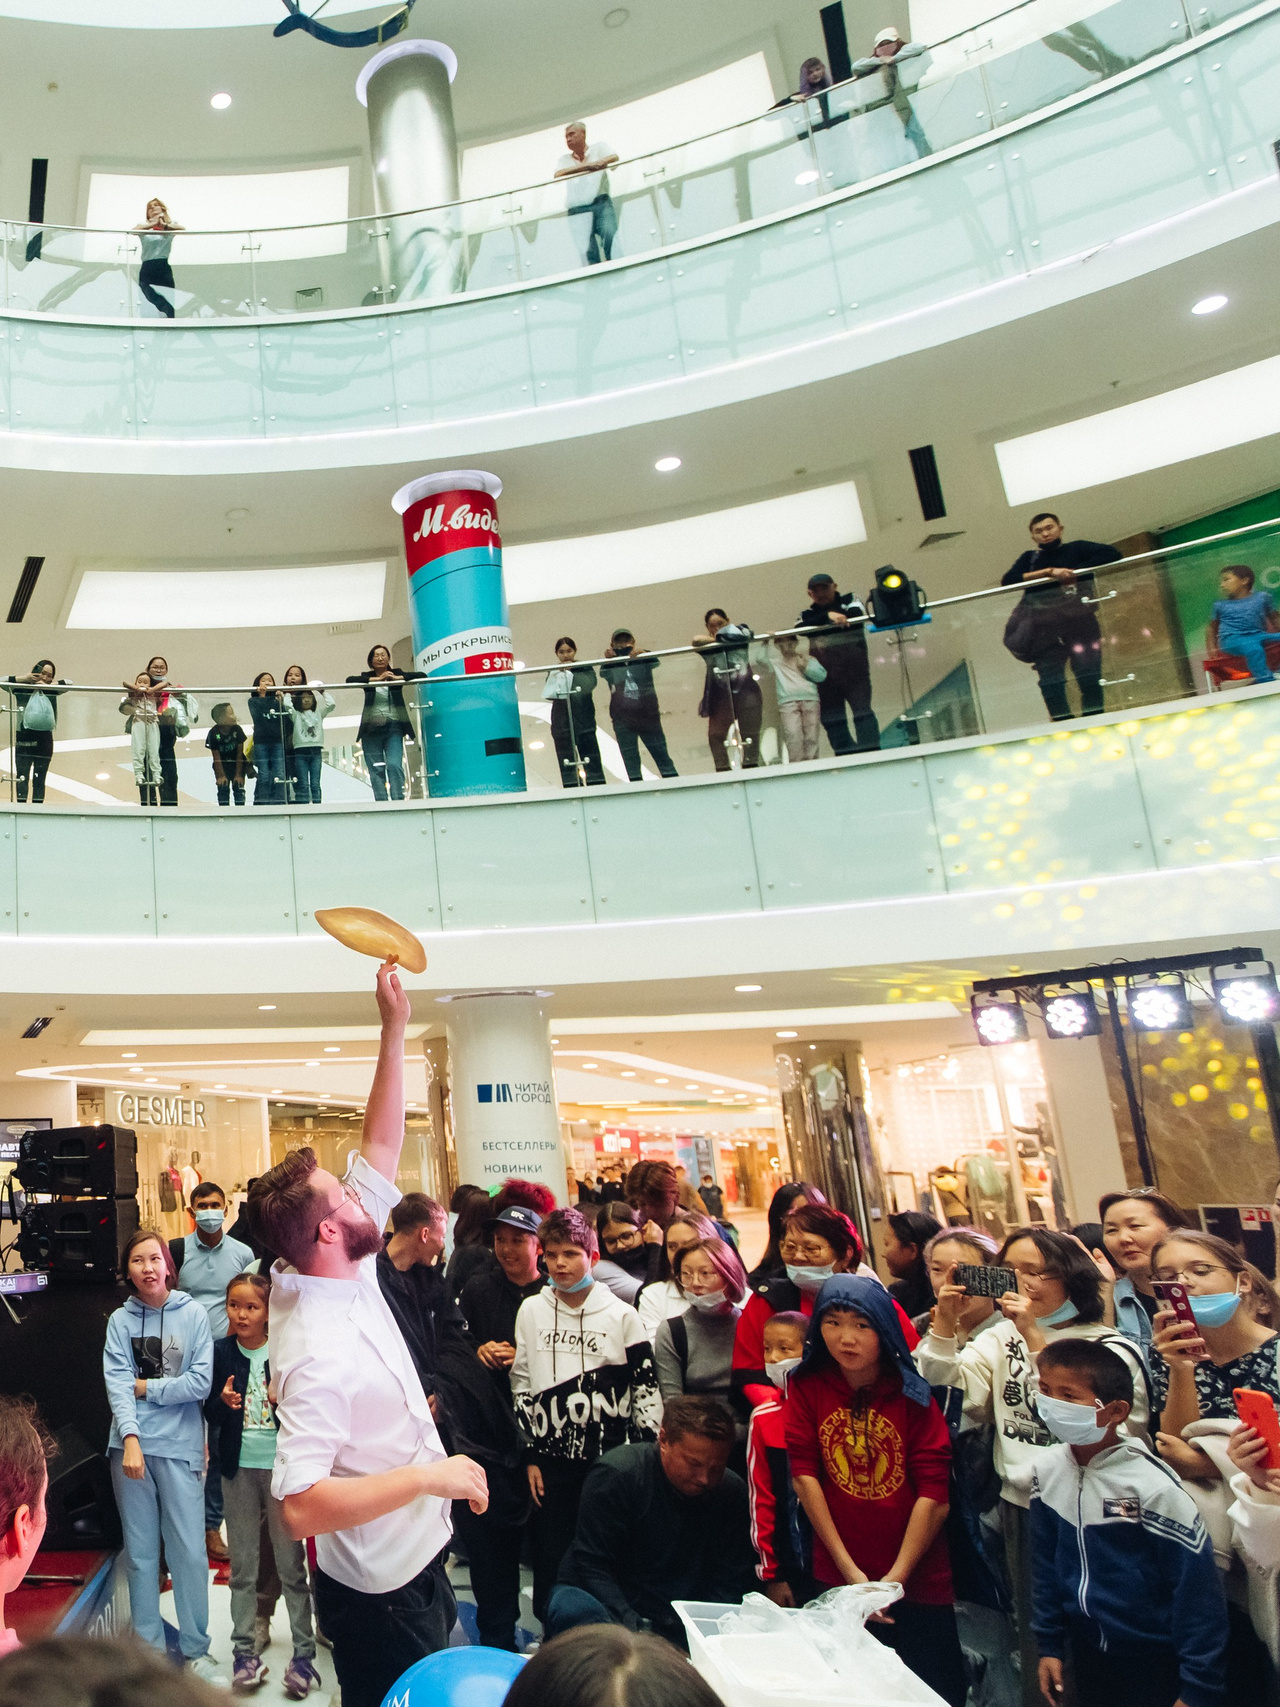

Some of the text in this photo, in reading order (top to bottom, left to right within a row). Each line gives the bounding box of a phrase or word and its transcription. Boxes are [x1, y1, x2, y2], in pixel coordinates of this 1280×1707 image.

[413, 504, 499, 543] М.виде
[422, 651, 440, 667] МЫ
[482, 657, 514, 669] 3 ЭТА
[514, 1081, 550, 1093] ЧИТАЙ
[515, 1093, 552, 1104] ГОРОД
[118, 1094, 206, 1128] GESMER
[482, 1141, 557, 1151] БЕСТСЕЛЛЕРЫ
[484, 1164, 542, 1174] НОВИНКИ
[510, 1210, 525, 1221] UFC
[36, 1274, 48, 1286] 61
